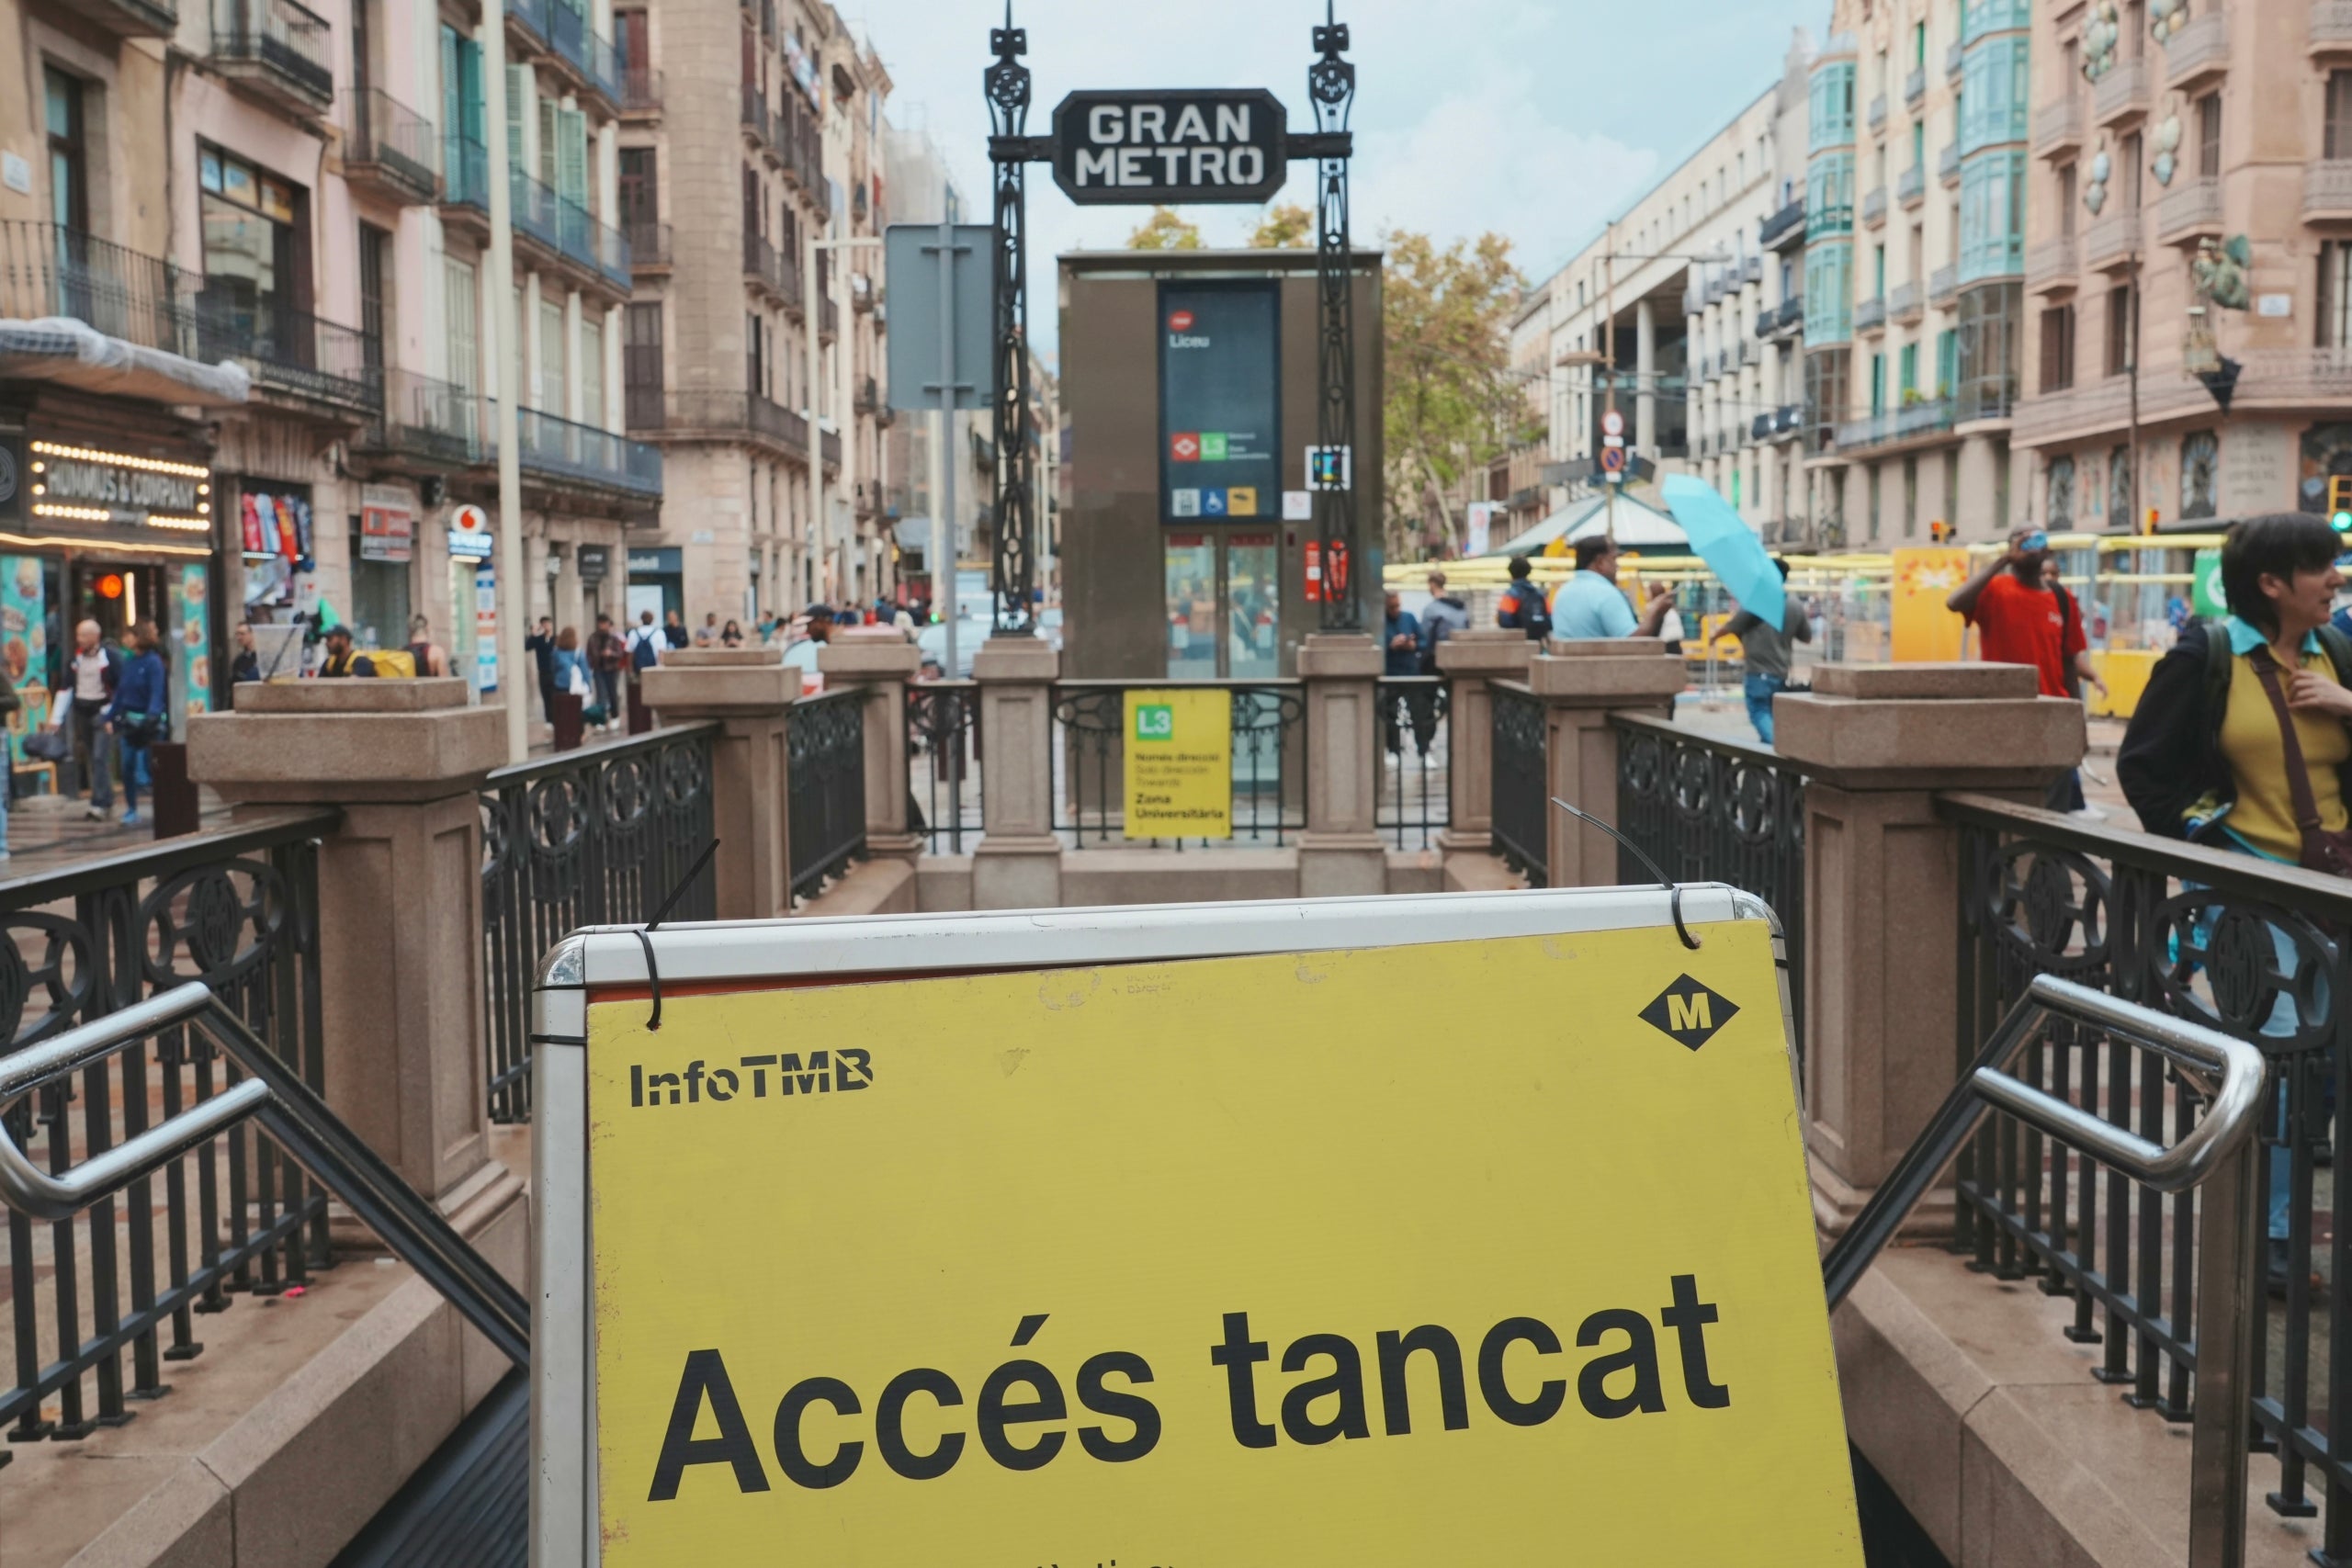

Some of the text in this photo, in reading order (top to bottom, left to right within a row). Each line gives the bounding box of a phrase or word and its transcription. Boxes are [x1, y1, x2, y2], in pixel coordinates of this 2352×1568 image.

[1088, 104, 1250, 144] GRAN
[1075, 146, 1264, 186] METRO
[1169, 333, 1210, 348] Liceu
[1201, 438, 1226, 456] L3
[49, 461, 196, 511] HUMMUS & COMPANY
[1138, 710, 1171, 734] L3
[1136, 794, 1171, 805] Zona
[1667, 992, 1713, 1032] M
[630, 1048, 874, 1108] InfoTMB
[647, 1273, 1731, 1503] Accés tancat
